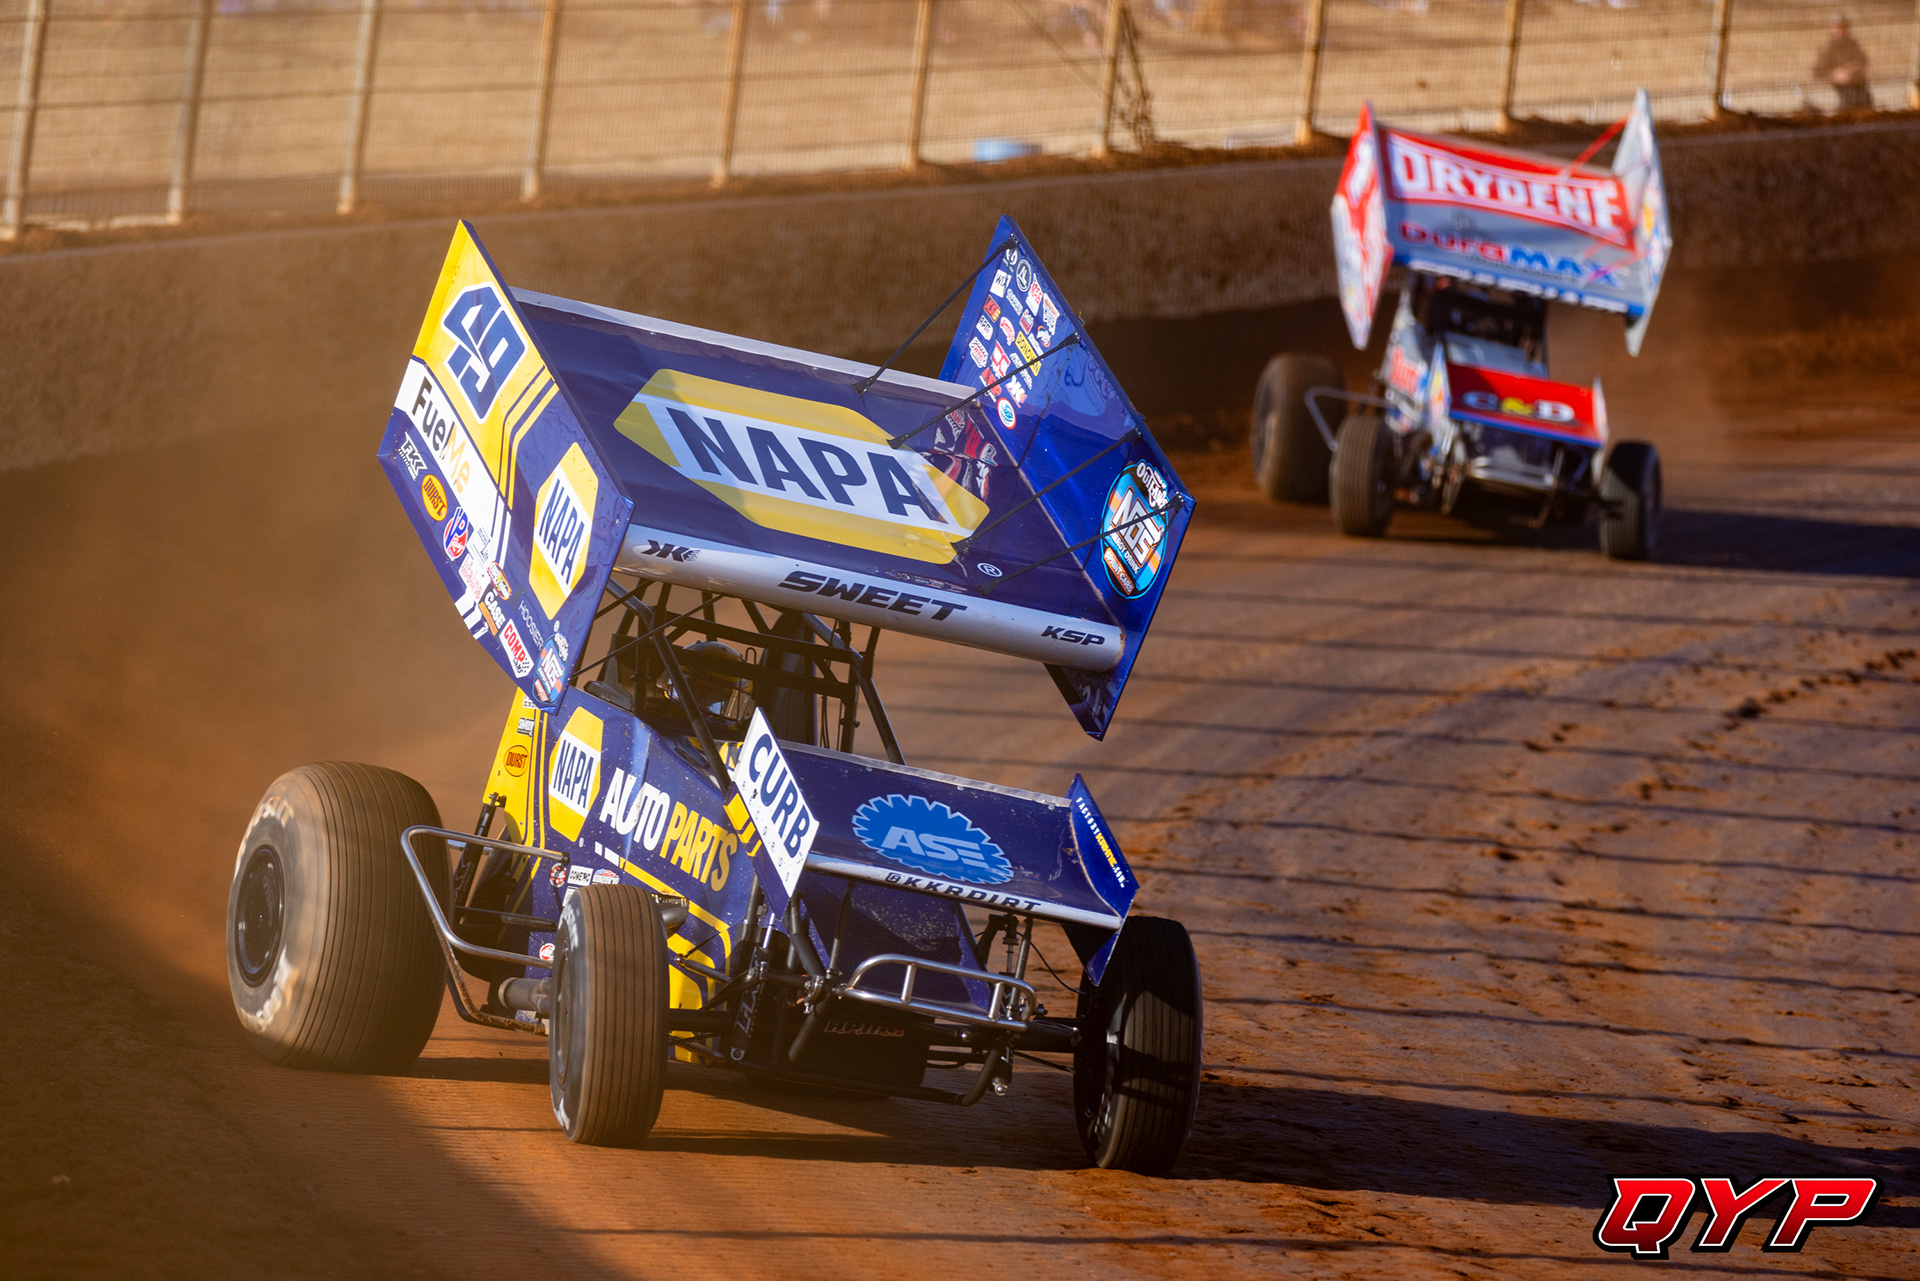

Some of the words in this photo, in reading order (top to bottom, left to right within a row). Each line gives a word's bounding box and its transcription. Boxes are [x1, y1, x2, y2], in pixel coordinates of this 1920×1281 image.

[666, 407, 949, 525] NAPA
[423, 477, 446, 517] DURST
[538, 478, 585, 585] NAPA
[1111, 488, 1163, 565] NOS
[1104, 550, 1122, 577] SPRINT
[1119, 570, 1133, 594] CARS
[1124, 550, 1141, 575] DRINK
[484, 591, 506, 630] CASE
[777, 570, 968, 621] SWEET
[503, 624, 526, 662] COMP
[518, 600, 544, 651] HOOSIER
[1040, 625, 1106, 646] KSP
[506, 751, 528, 769] DURST
[553, 738, 595, 810] NAPA
[749, 733, 810, 859] CURB
[880, 825, 990, 869] ASE
